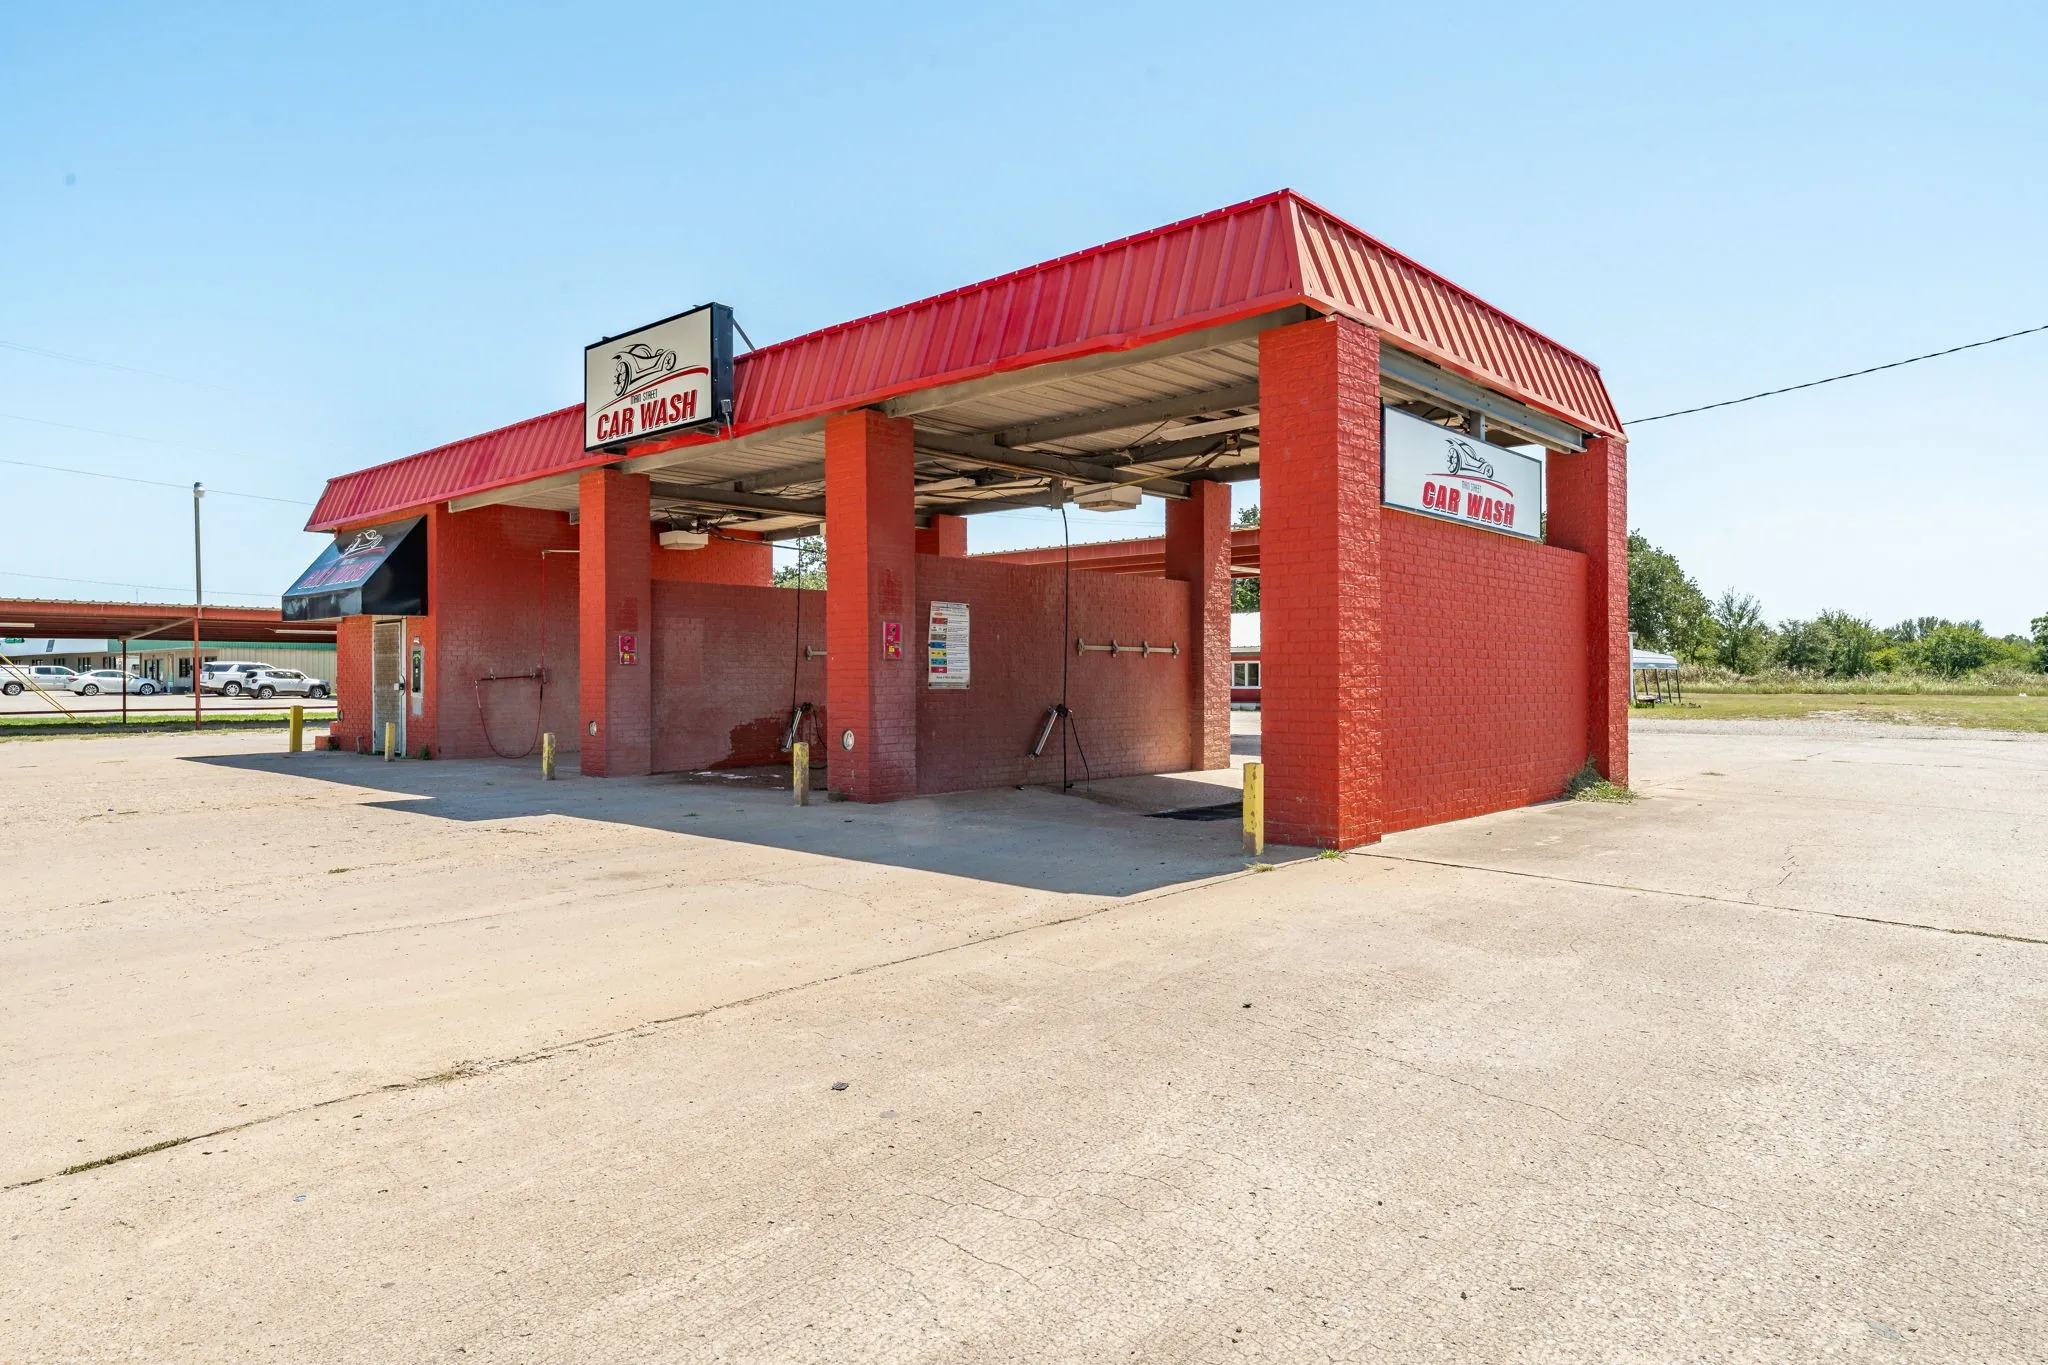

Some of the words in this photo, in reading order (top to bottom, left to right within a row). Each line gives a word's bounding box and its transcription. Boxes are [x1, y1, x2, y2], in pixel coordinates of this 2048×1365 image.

[642, 388, 658, 402] STREET
[597, 407, 635, 441] CAR
[640, 389, 698, 431] WASH
[1422, 481, 1460, 515] CAR
[1466, 492, 1515, 528] WASH
[297, 566, 337, 590] CAR
[324, 559, 379, 586] WASH
